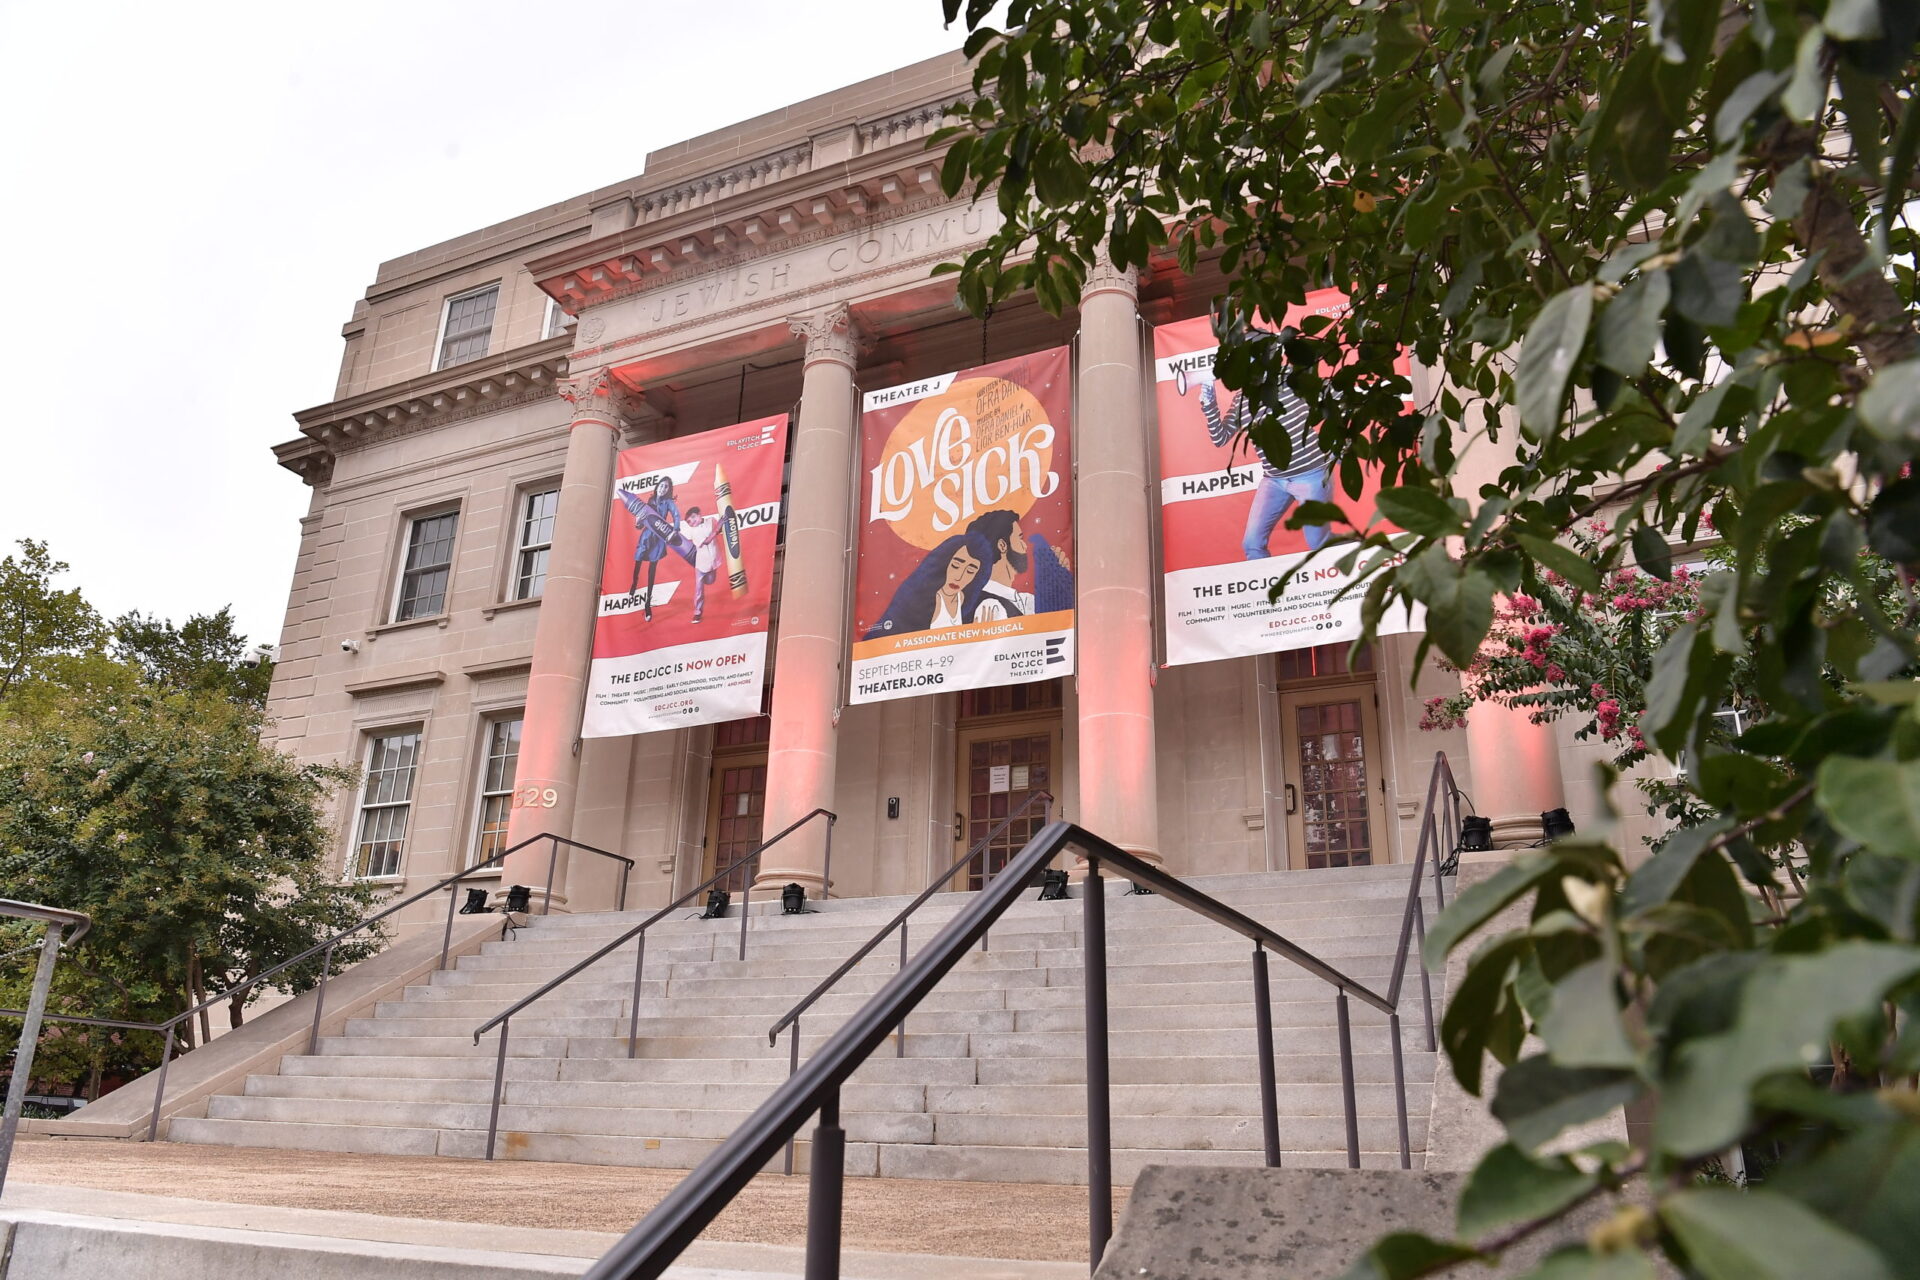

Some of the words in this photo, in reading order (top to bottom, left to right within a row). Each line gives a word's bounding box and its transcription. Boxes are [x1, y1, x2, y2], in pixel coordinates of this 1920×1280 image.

[652, 263, 790, 322] JEWISH
[1168, 353, 1217, 374] WHER
[872, 384, 929, 405] THEATER
[934, 381, 941, 390] J
[976, 389, 1000, 415] OFRA
[622, 475, 660, 491] WHERE
[1182, 470, 1254, 495] HAPPEN
[737, 506, 774, 528] YOU
[728, 517, 738, 549] Yellow
[1193, 584, 1223, 598] THE
[1228, 576, 1291, 595] EDCJC
[1296, 571, 1309, 584] IS
[1314, 566, 1340, 581] NO
[604, 593, 647, 611] HAPPEN
[1178, 610, 1192, 618] FILM
[1198, 606, 1225, 614] THEATER
[1231, 602, 1252, 610] MUSIC
[1286, 594, 1306, 602] EARLY
[1185, 615, 1225, 626] COMMUNITY
[1233, 607, 1283, 619] VOLUNTEERING
[1284, 604, 1298, 612] AND
[1299, 601, 1322, 609] SOCIAL
[1269, 612, 1332, 628] EDCJCC.ORG
[894, 641, 902, 649] A
[902, 631, 957, 648] PASSIONATE
[958, 627, 981, 640] NEW
[983, 621, 1024, 637] MUSICAL
[994, 649, 1044, 662] EDLAVITCH
[1011, 660, 1044, 669] DCJCC
[610, 673, 631, 685] THE
[634, 665, 672, 681] EDCJCC
[673, 663, 683, 674] IS
[686, 657, 714, 671] NOW
[716, 653, 747, 667] OPEN
[859, 658, 922, 680] SEPTEMBER
[858, 673, 944, 695] THEATERJ.ORG
[654, 699, 694, 711] EDCJCC.ORG
